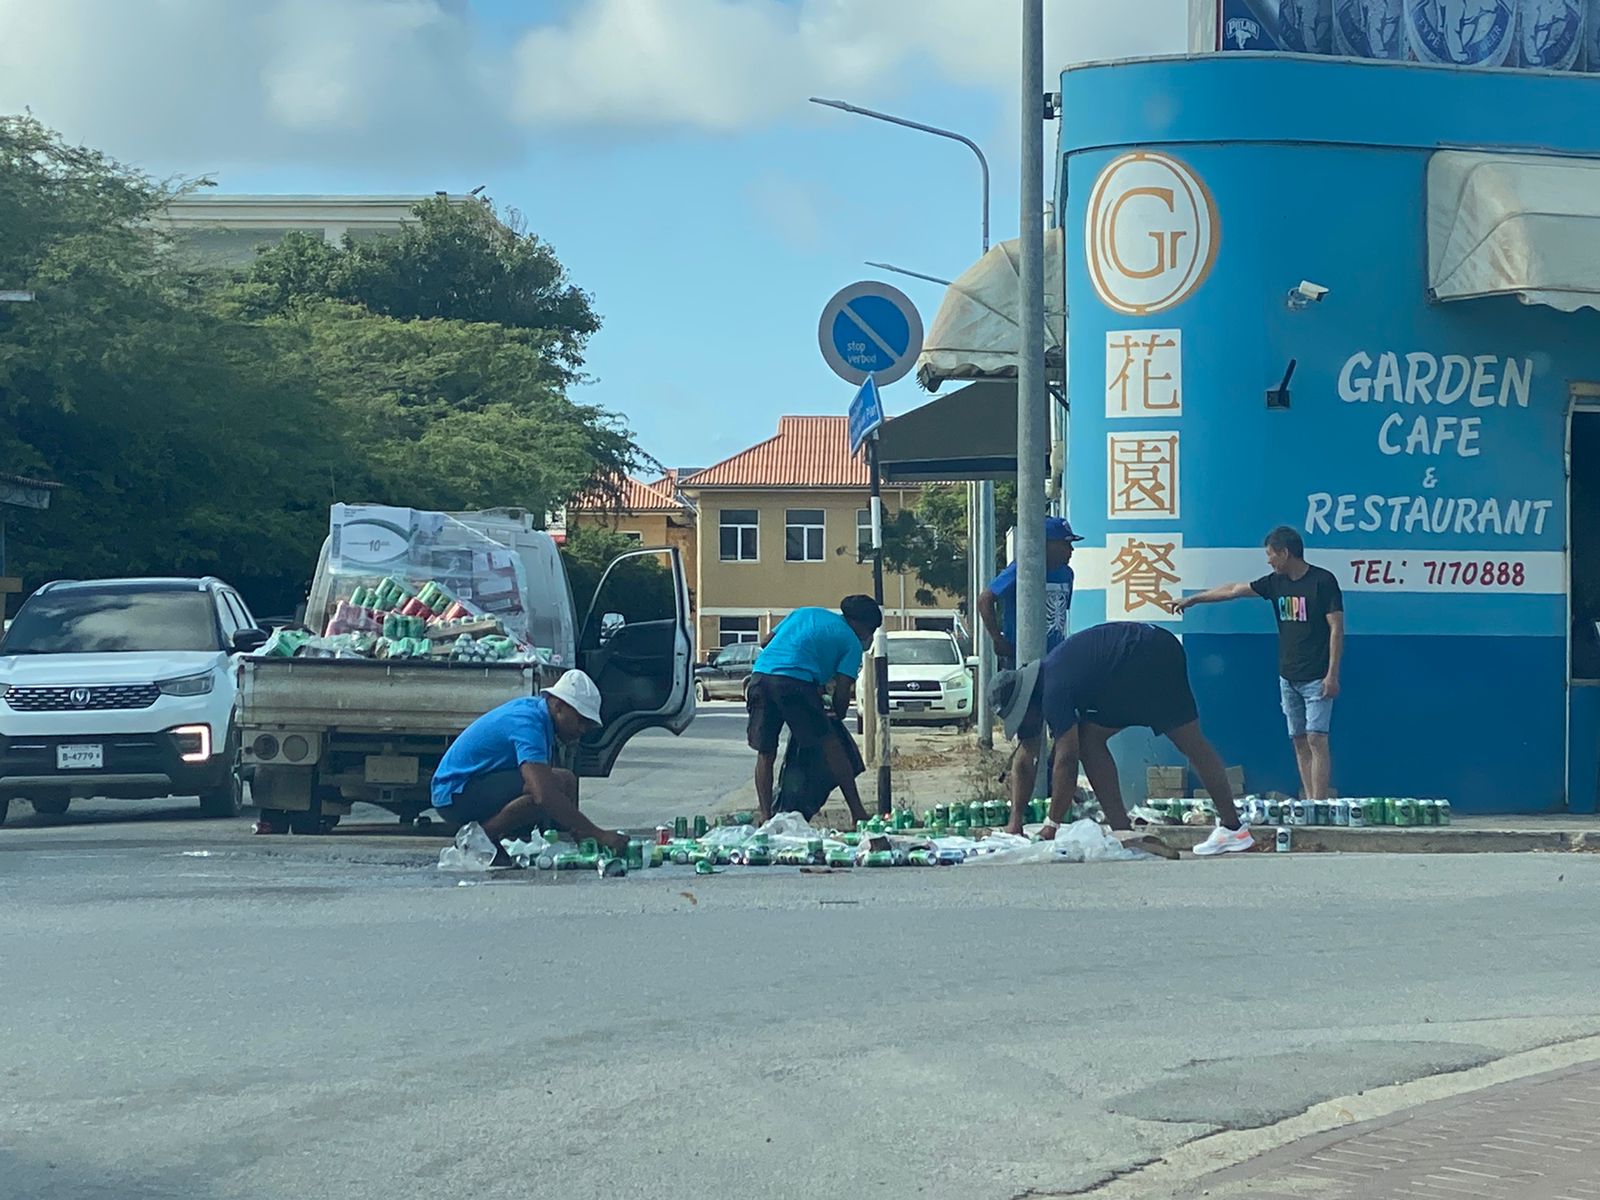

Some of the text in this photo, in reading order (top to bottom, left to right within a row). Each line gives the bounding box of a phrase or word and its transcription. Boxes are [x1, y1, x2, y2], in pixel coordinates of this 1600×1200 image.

[1228, 19, 1257, 36] POLAR
[847, 341, 866, 354] stop
[848, 354, 877, 364] verbod
[1337, 351, 1533, 407] GARDEN
[1378, 412, 1481, 457] CAFE
[1422, 467, 1437, 488] &
[1305, 493, 1552, 535] RESTAURANT
[1350, 560, 1525, 586] TEL: 7170888
